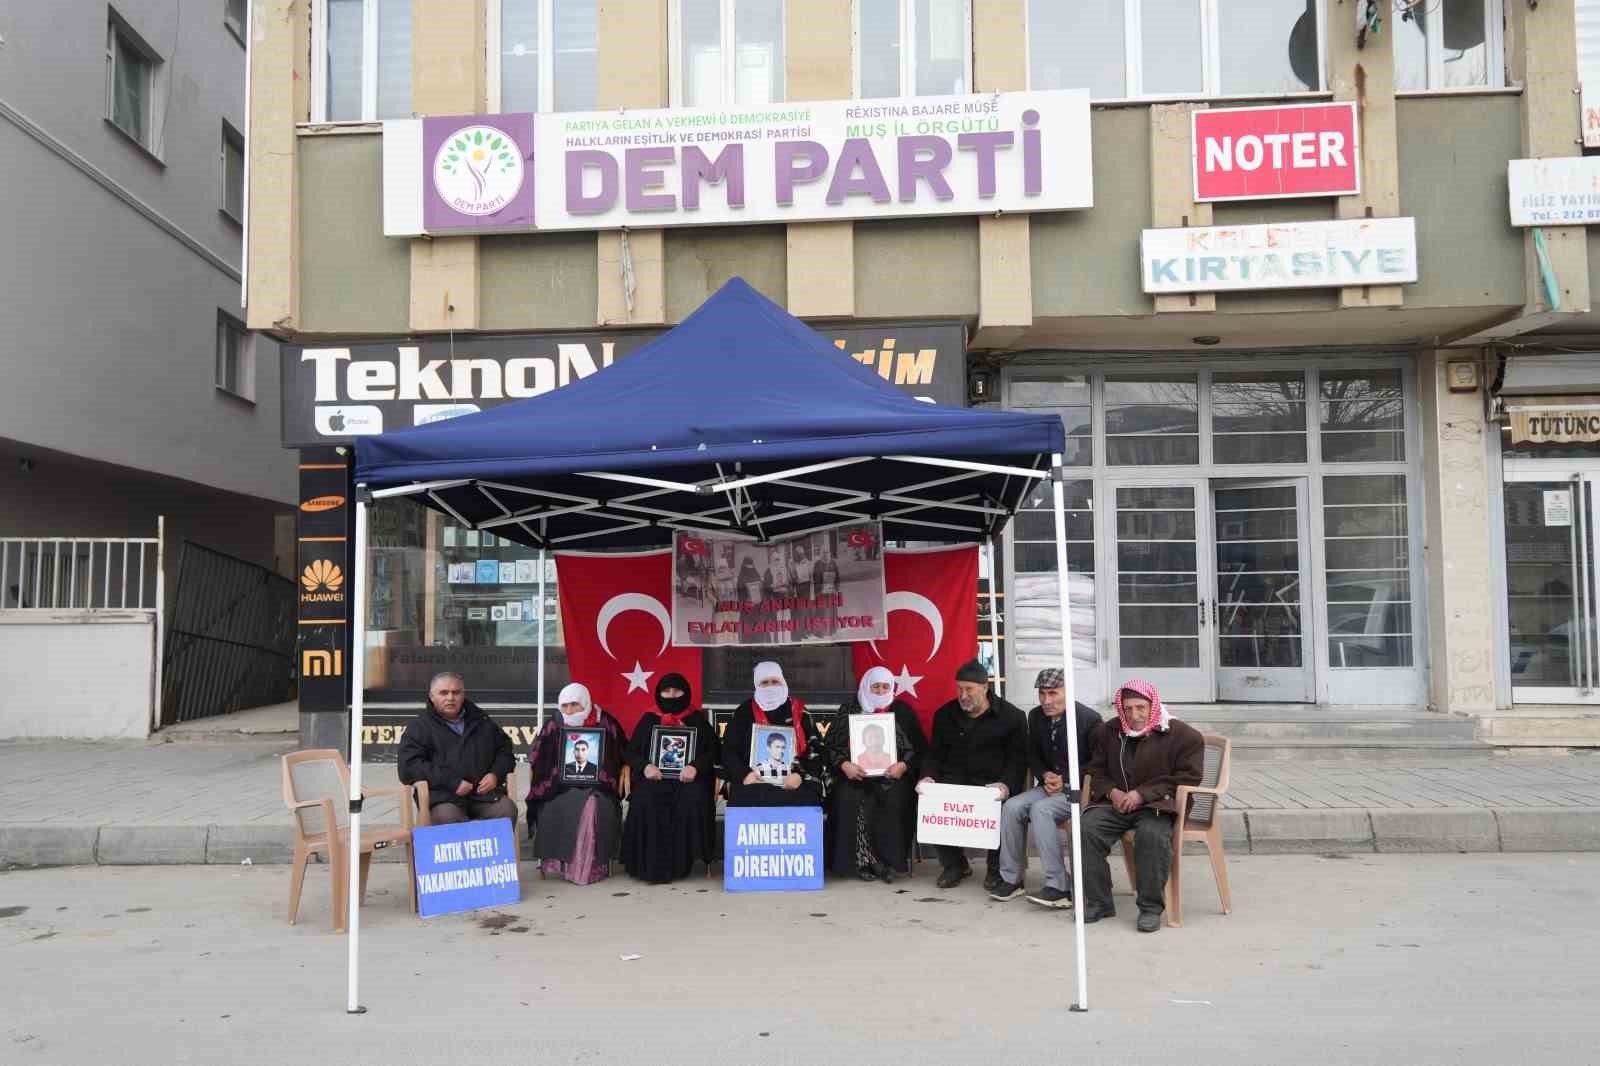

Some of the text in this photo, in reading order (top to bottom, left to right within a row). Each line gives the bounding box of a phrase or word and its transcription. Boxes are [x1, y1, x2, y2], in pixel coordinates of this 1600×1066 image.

[565, 124, 811, 148] HALKLARIN EŞİTLİK VE DEMOKRASİ PARTİSİ
[611, 118, 652, 131] GELAN
[846, 116, 1000, 140] MUŞ İL ÖRGÜTÜ
[565, 108, 1043, 217] DEM PARTİ
[1205, 131, 1348, 172] NOTER
[1152, 247, 1407, 284] KIRTASİYE
[301, 593, 344, 602] HUAWEI
[943, 802, 976, 813] EVLAT
[922, 812, 997, 830] NÖBETİNDEYİZ
[737, 822, 807, 846] ANNELER
[434, 841, 464, 864] ARTIK
[463, 837, 494, 860] YETER
[733, 847, 816, 878] DİRENİYOR
[417, 858, 519, 895] YAKAMIZDAN DÜŞÜN
